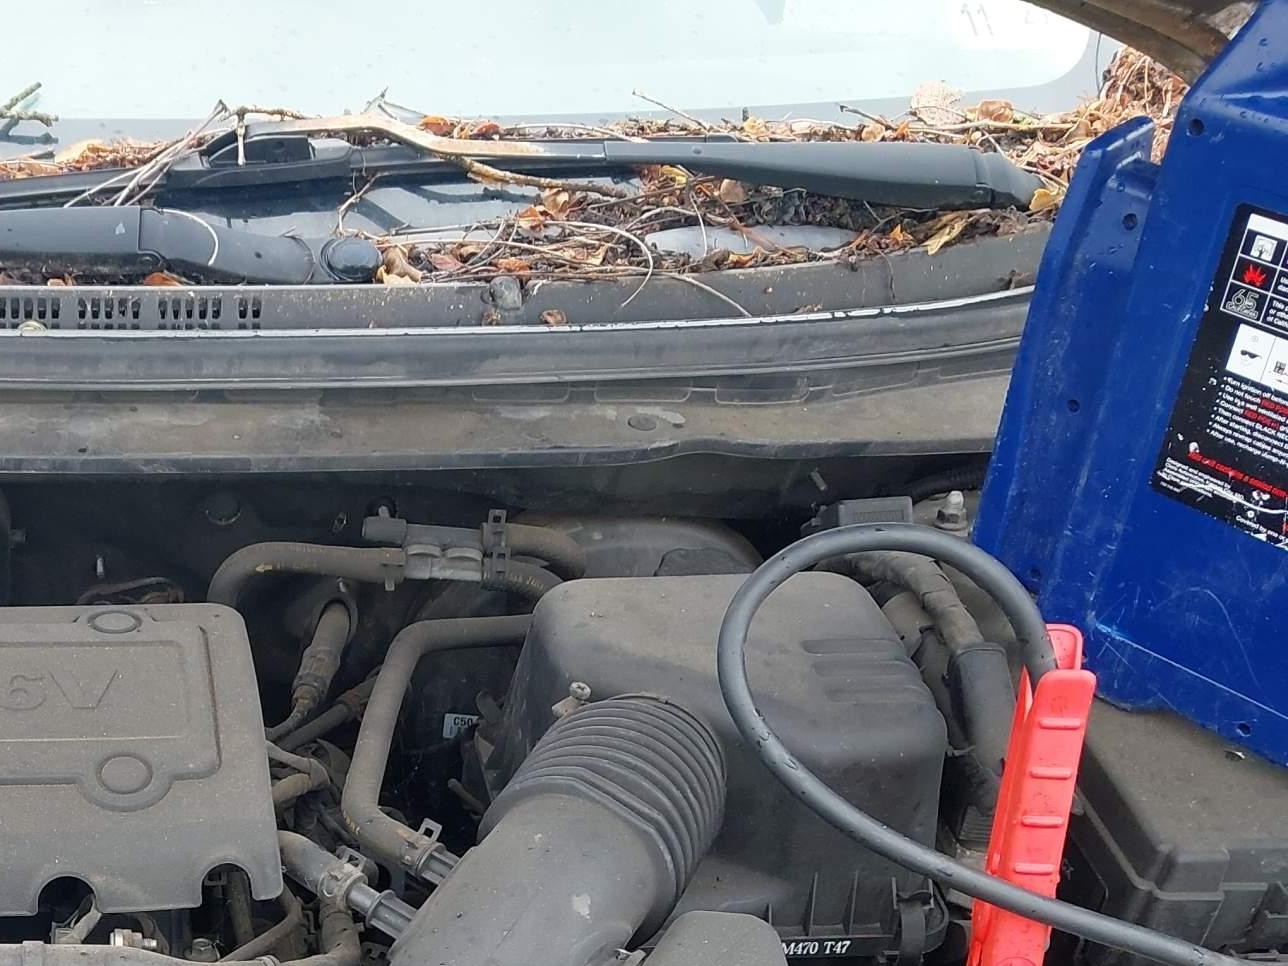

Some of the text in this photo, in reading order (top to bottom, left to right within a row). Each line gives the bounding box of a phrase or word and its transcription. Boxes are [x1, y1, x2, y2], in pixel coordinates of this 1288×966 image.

[1232, 289, 1260, 311] 65
[1234, 389, 1244, 397] not
[1219, 400, 1244, 414] Connect
[1218, 407, 1232, 417] Then
[1255, 422, 1277, 436] BLACK
[823, 940, 851, 954] T47
